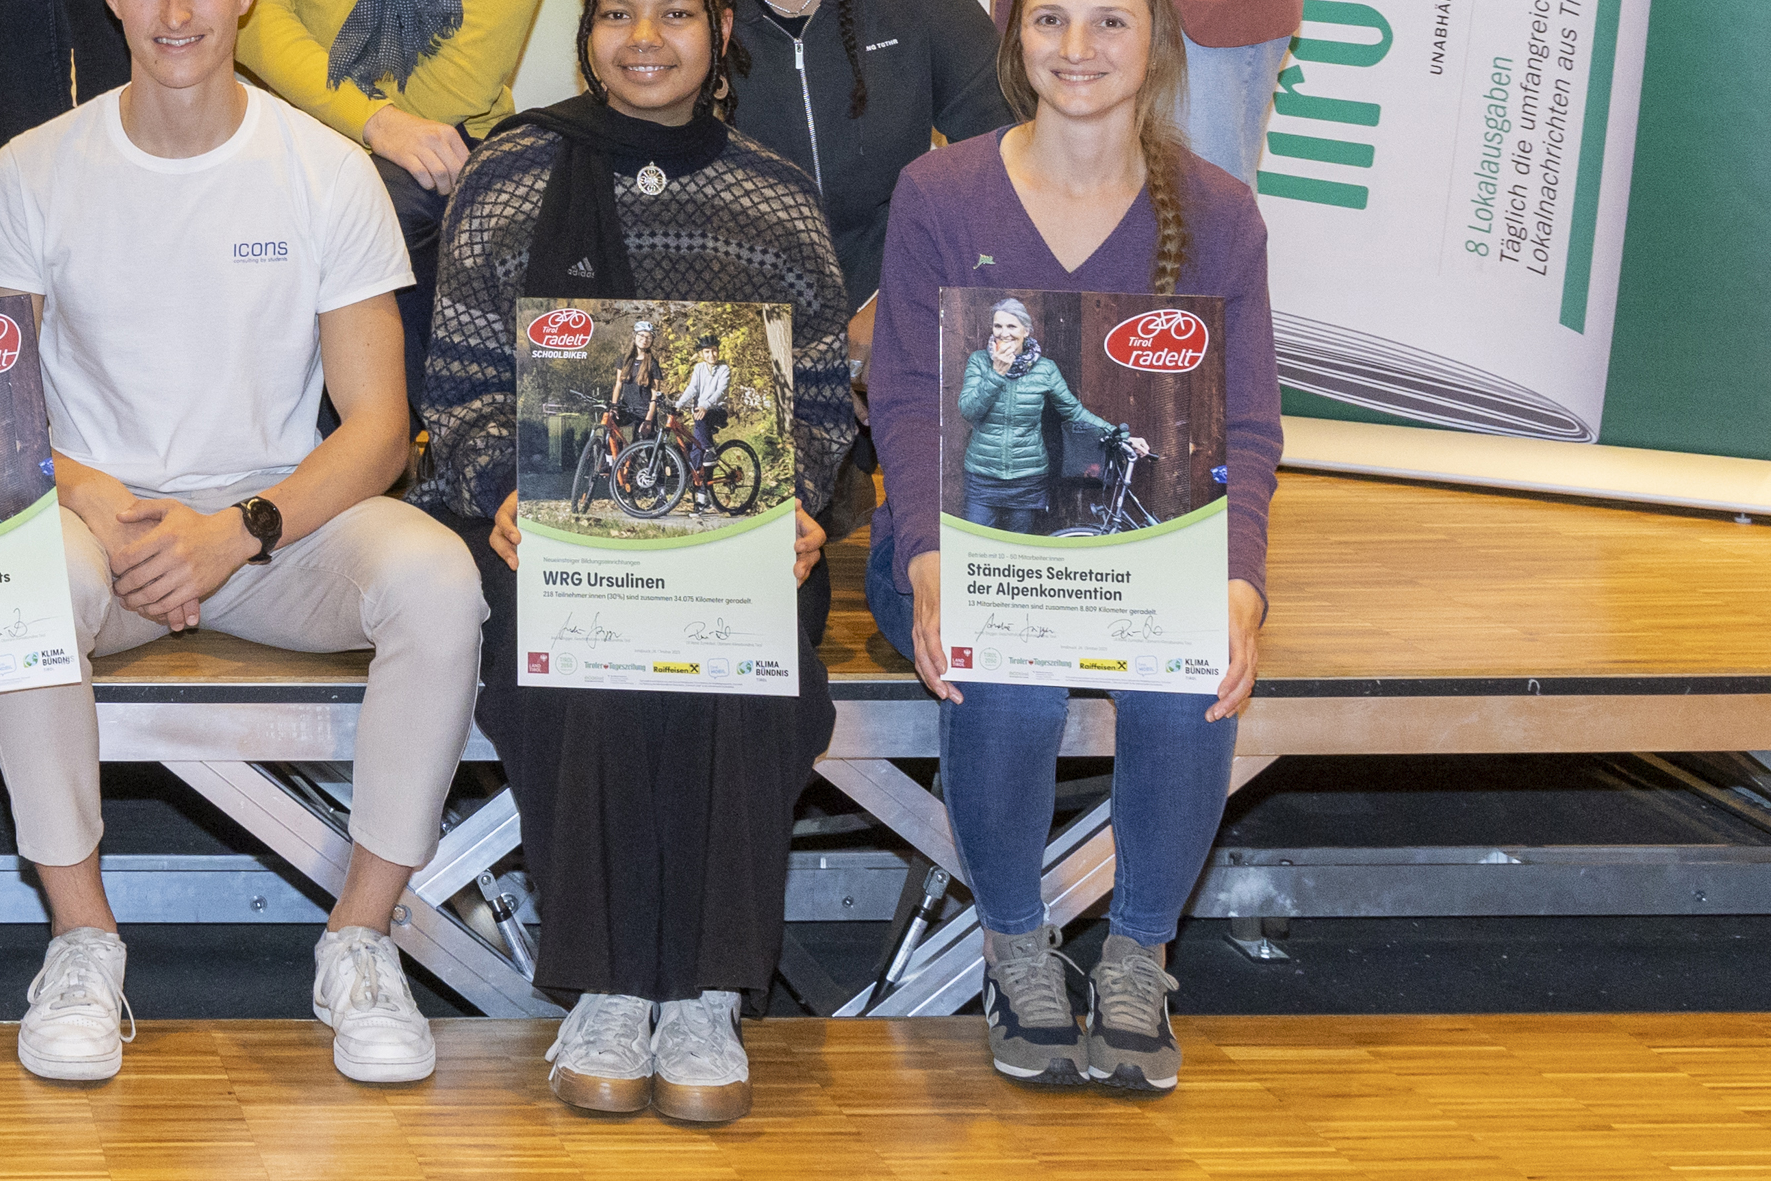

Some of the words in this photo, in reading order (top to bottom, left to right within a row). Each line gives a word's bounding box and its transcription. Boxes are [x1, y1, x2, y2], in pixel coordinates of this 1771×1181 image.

[1471, 56, 1513, 234] Lokalausgaben
[1526, 79, 1572, 276] Lokalnachrichten
[1558, 27, 1577, 71] aus
[1511, 140, 1532, 175] die
[1499, 184, 1528, 264] Täglich
[1465, 238, 1489, 257] 8
[543, 334, 584, 346] radelt
[1129, 336, 1153, 347] Tirol
[532, 350, 587, 359] SCHOOLBIKER
[1129, 348, 1194, 367] radelt
[543, 570, 582, 587] WRG
[587, 572, 665, 589] Ursulinen
[967, 563, 1042, 582] Ständiges
[1046, 567, 1131, 584] Sekretariat
[555, 591, 606, 599] Teilnehmer:innen
[967, 581, 992, 595] der
[996, 582, 1122, 601] Alpenkonvention
[976, 600, 1029, 609] Mitarbeiter:innen
[1099, 606, 1128, 614] Kilometer
[1129, 608, 1157, 616] geradelt.
[41, 649, 64, 658] KLIMA
[756, 660, 779, 668] KLIMA
[756, 667, 789, 677] BÜNDNIS
[1185, 667, 1219, 675] BÜNDNIS
